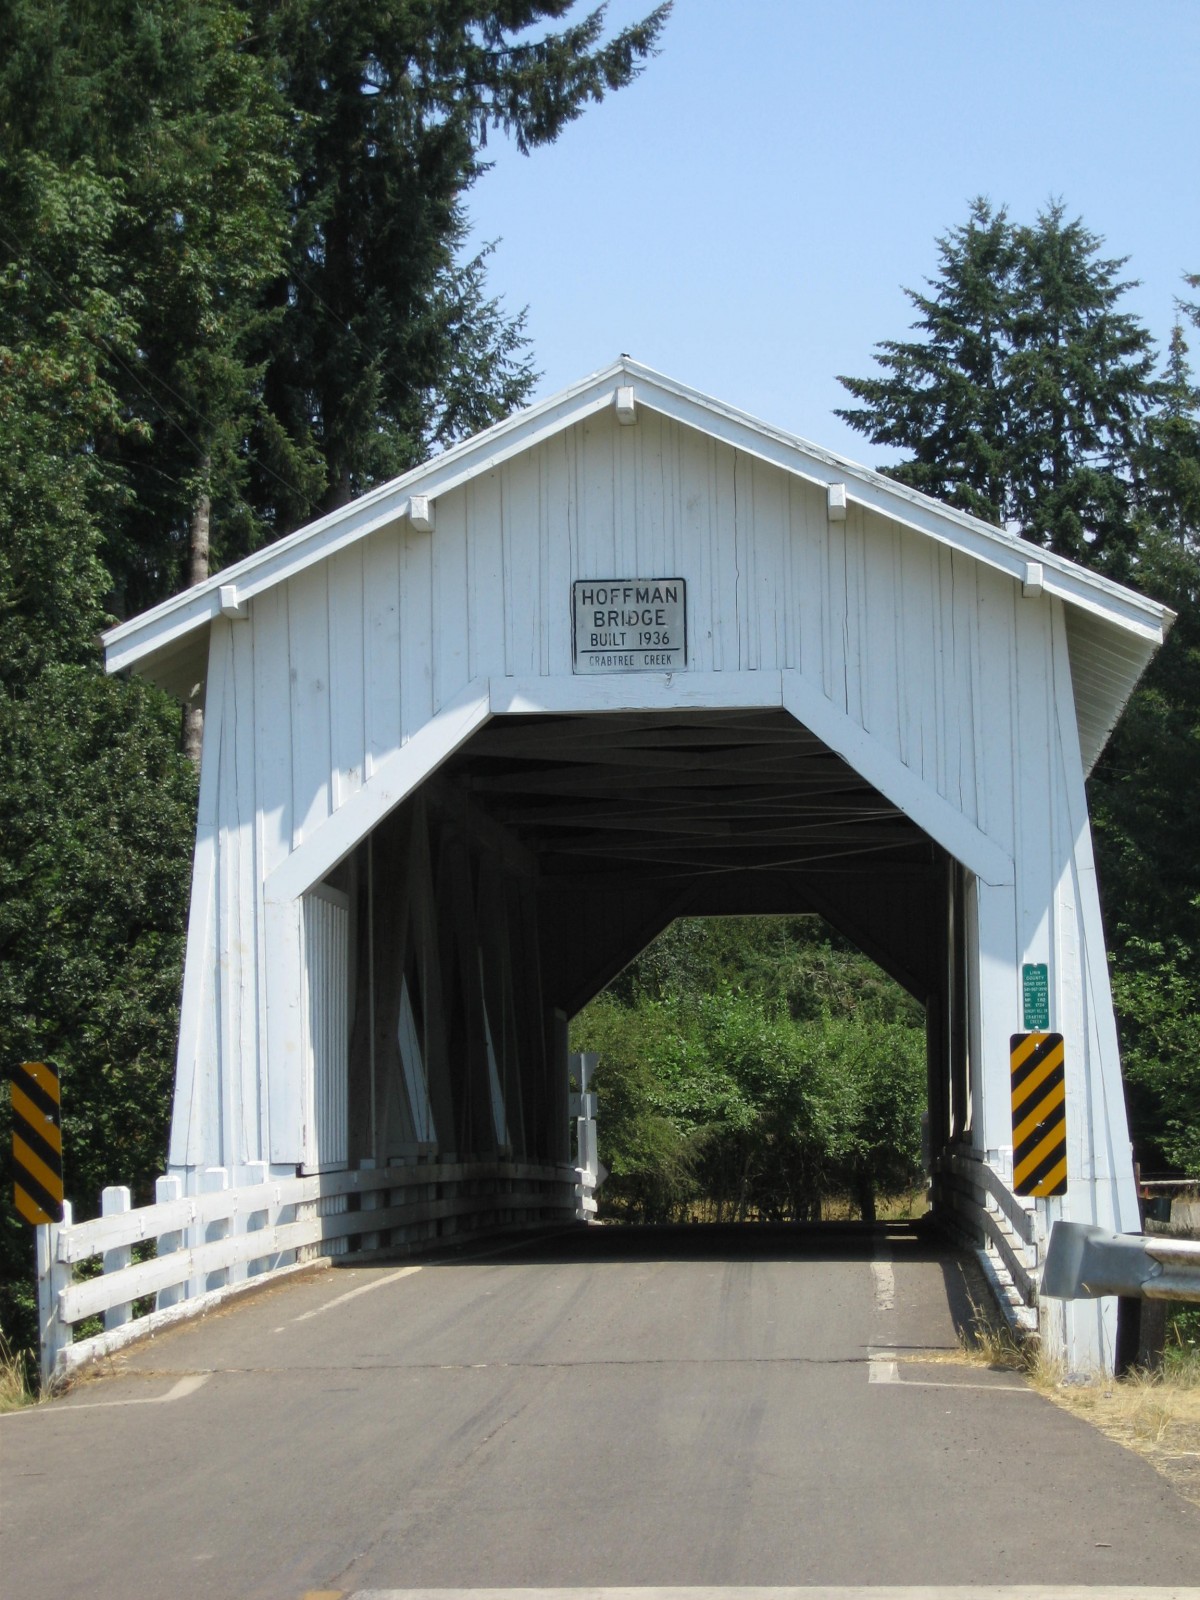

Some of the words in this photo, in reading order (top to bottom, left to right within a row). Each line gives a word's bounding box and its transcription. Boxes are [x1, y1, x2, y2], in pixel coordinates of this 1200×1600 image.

[582, 587, 678, 605] HOFFMAN
[594, 609, 666, 627] BRIDGE
[590, 632, 626, 647] BUILT
[639, 631, 670, 646] 1936
[589, 655, 634, 667] CRABTREE
[644, 654, 672, 665] CREEK
